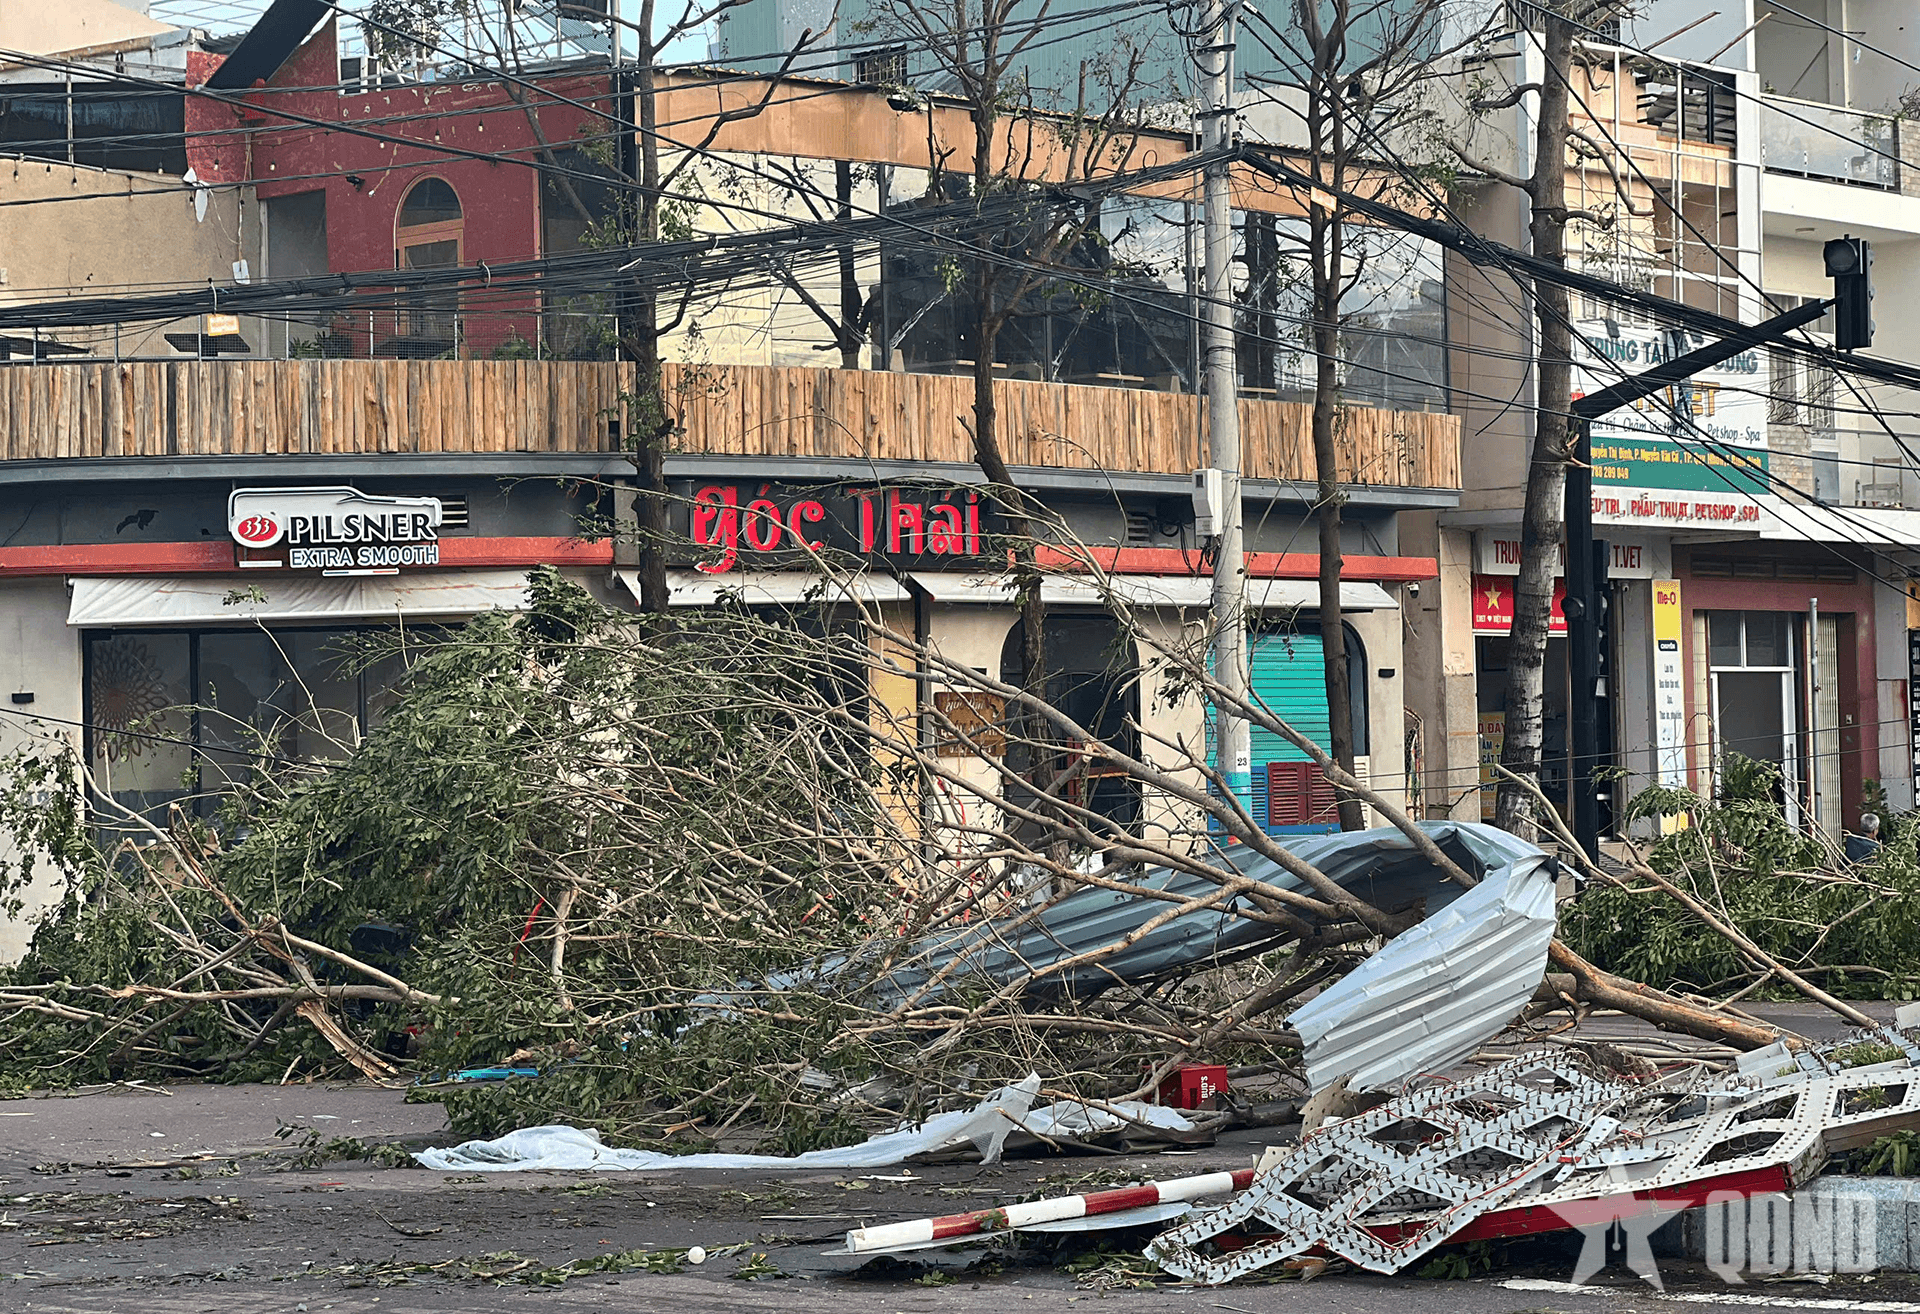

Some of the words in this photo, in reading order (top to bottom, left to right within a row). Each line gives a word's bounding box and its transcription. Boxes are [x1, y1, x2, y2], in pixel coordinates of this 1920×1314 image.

[1586, 337, 1638, 363] TRUNG
[1745, 426, 1761, 444] Spa
[847, 488, 980, 555] Thái
[1742, 505, 1760, 521] SPA
[244, 515, 271, 538] 333
[288, 513, 438, 544] PILSNER
[290, 548, 354, 568] EXTRA
[357, 546, 439, 567] SMOOTH
[1494, 540, 1522, 564] TRUN
[1237, 757, 1248, 767] 23
